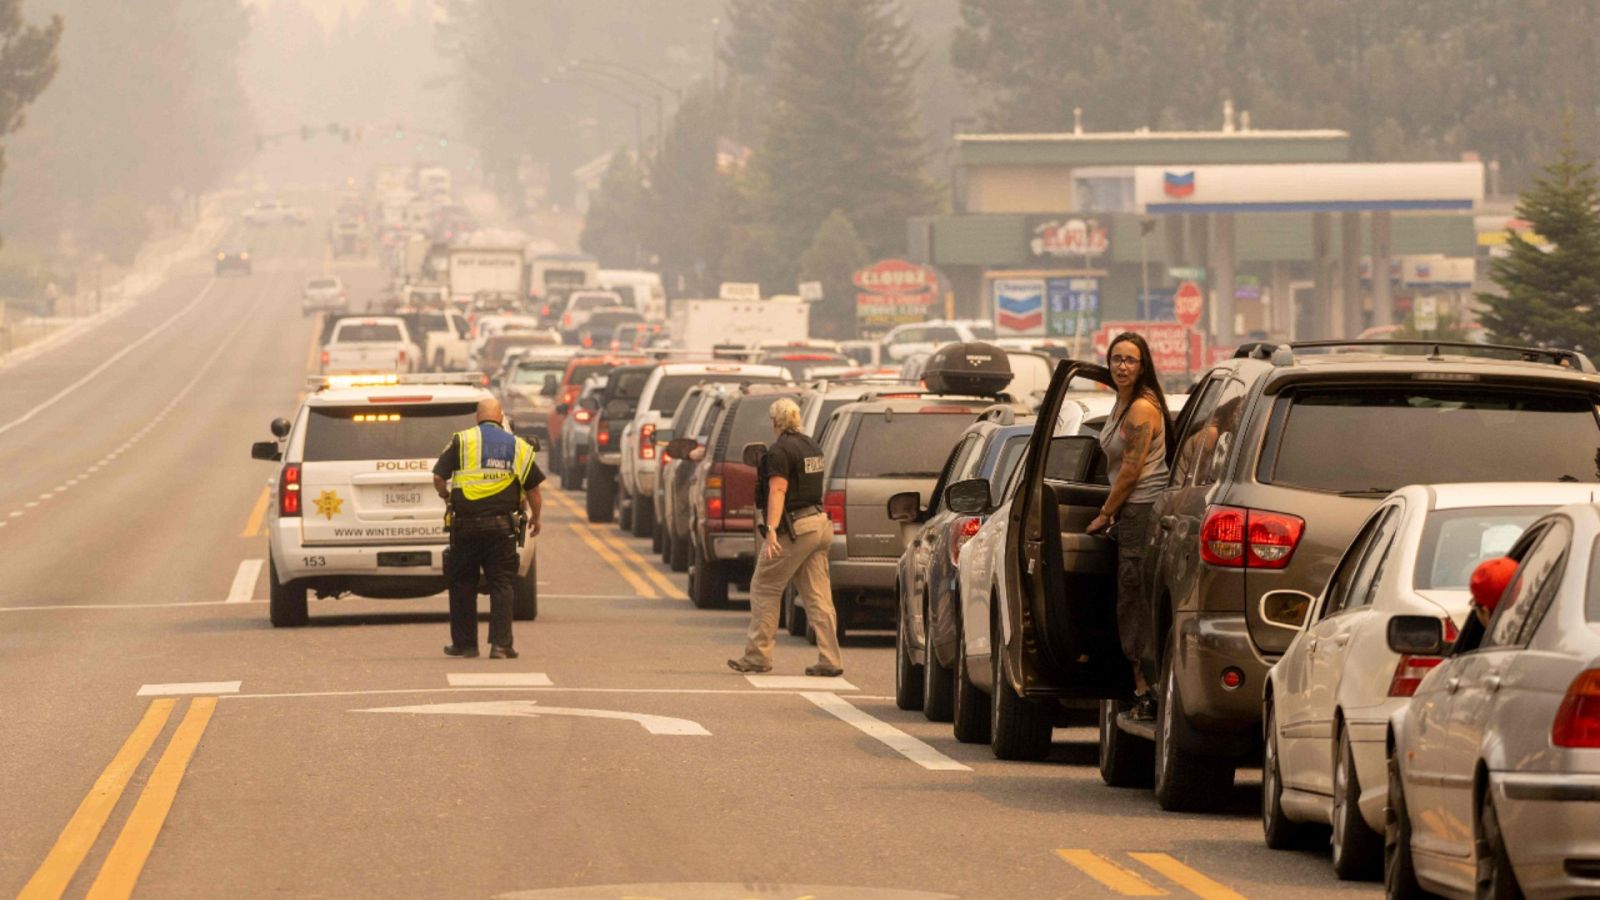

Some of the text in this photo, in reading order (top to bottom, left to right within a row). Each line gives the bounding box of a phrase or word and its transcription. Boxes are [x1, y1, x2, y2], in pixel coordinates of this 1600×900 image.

[998, 283, 1042, 291] Chevron
[1175, 296, 1201, 315] STOP
[376, 460, 428, 471] POLICE
[385, 494, 421, 504] 1498483
[333, 529, 363, 537] WWW
[302, 556, 326, 567] 153
